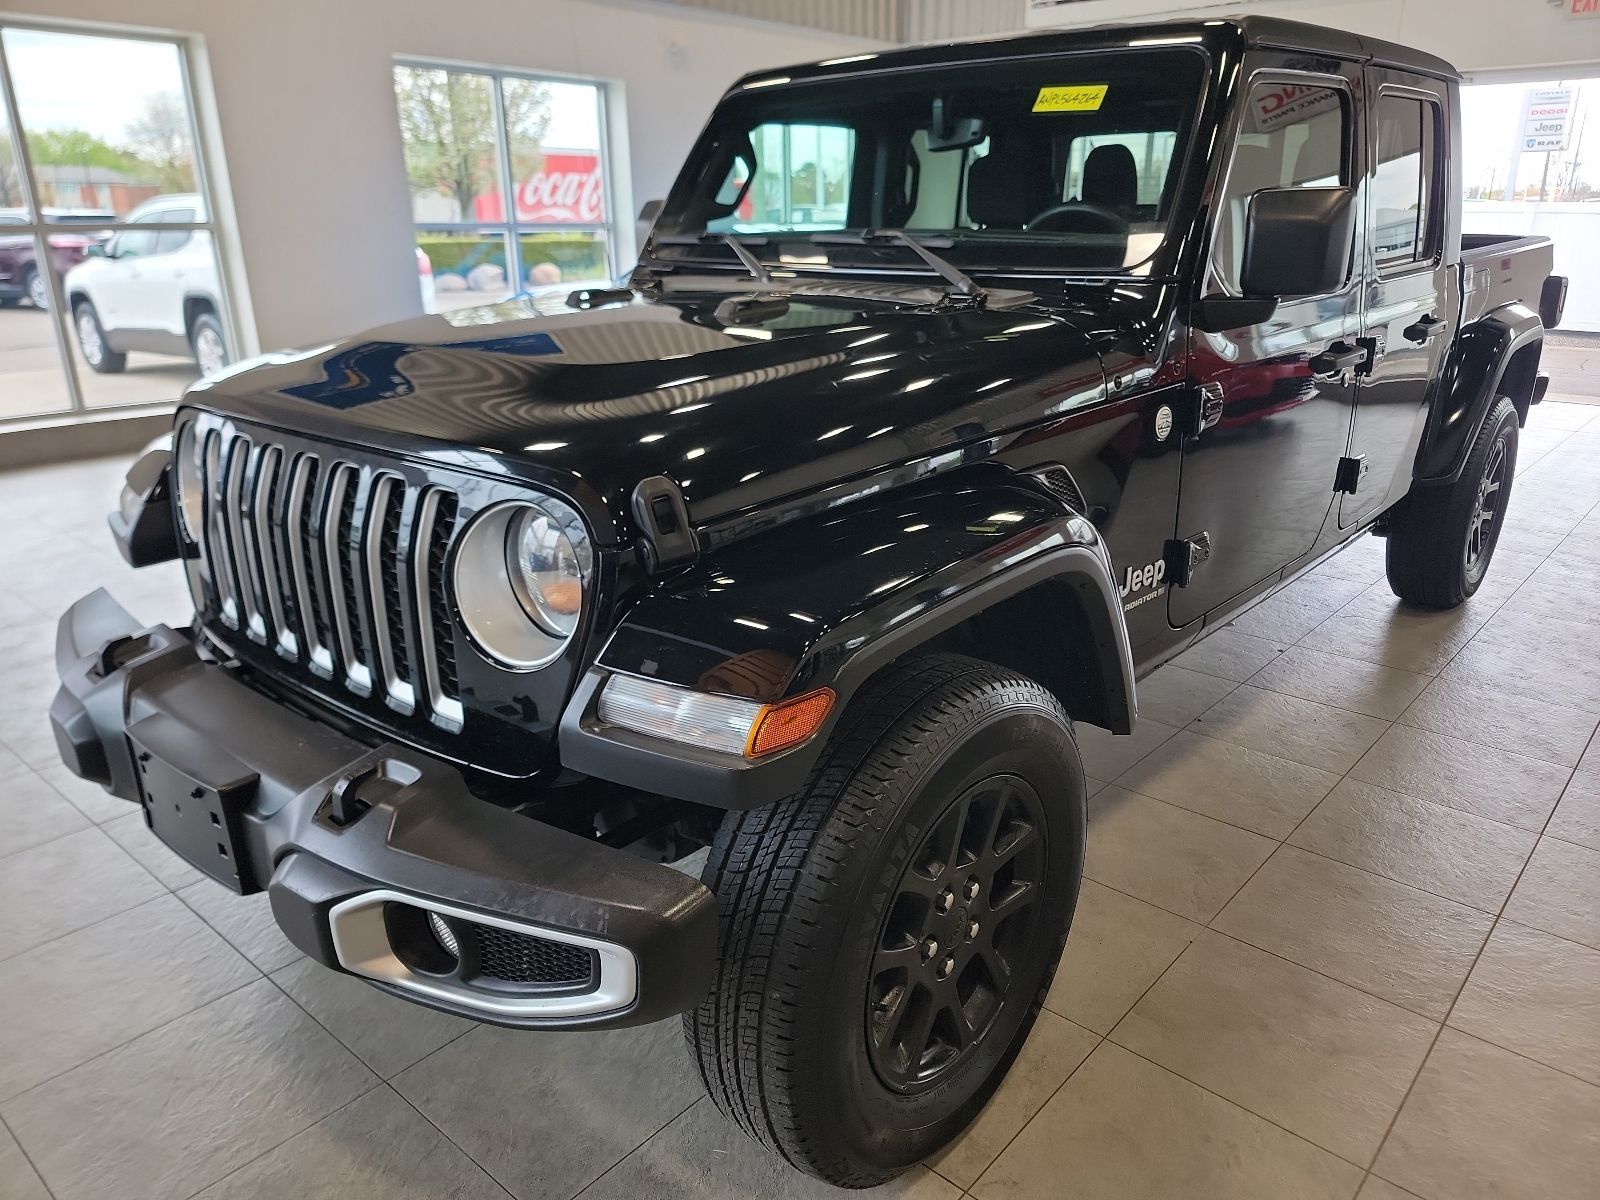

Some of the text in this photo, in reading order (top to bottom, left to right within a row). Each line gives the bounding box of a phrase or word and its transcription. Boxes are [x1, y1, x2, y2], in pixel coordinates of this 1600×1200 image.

[1571, 0, 1597, 13] EXI
[1534, 122, 1563, 133] Jeep
[1119, 559, 1166, 598] Jeep
[1124, 590, 1159, 612] ADIATOR
